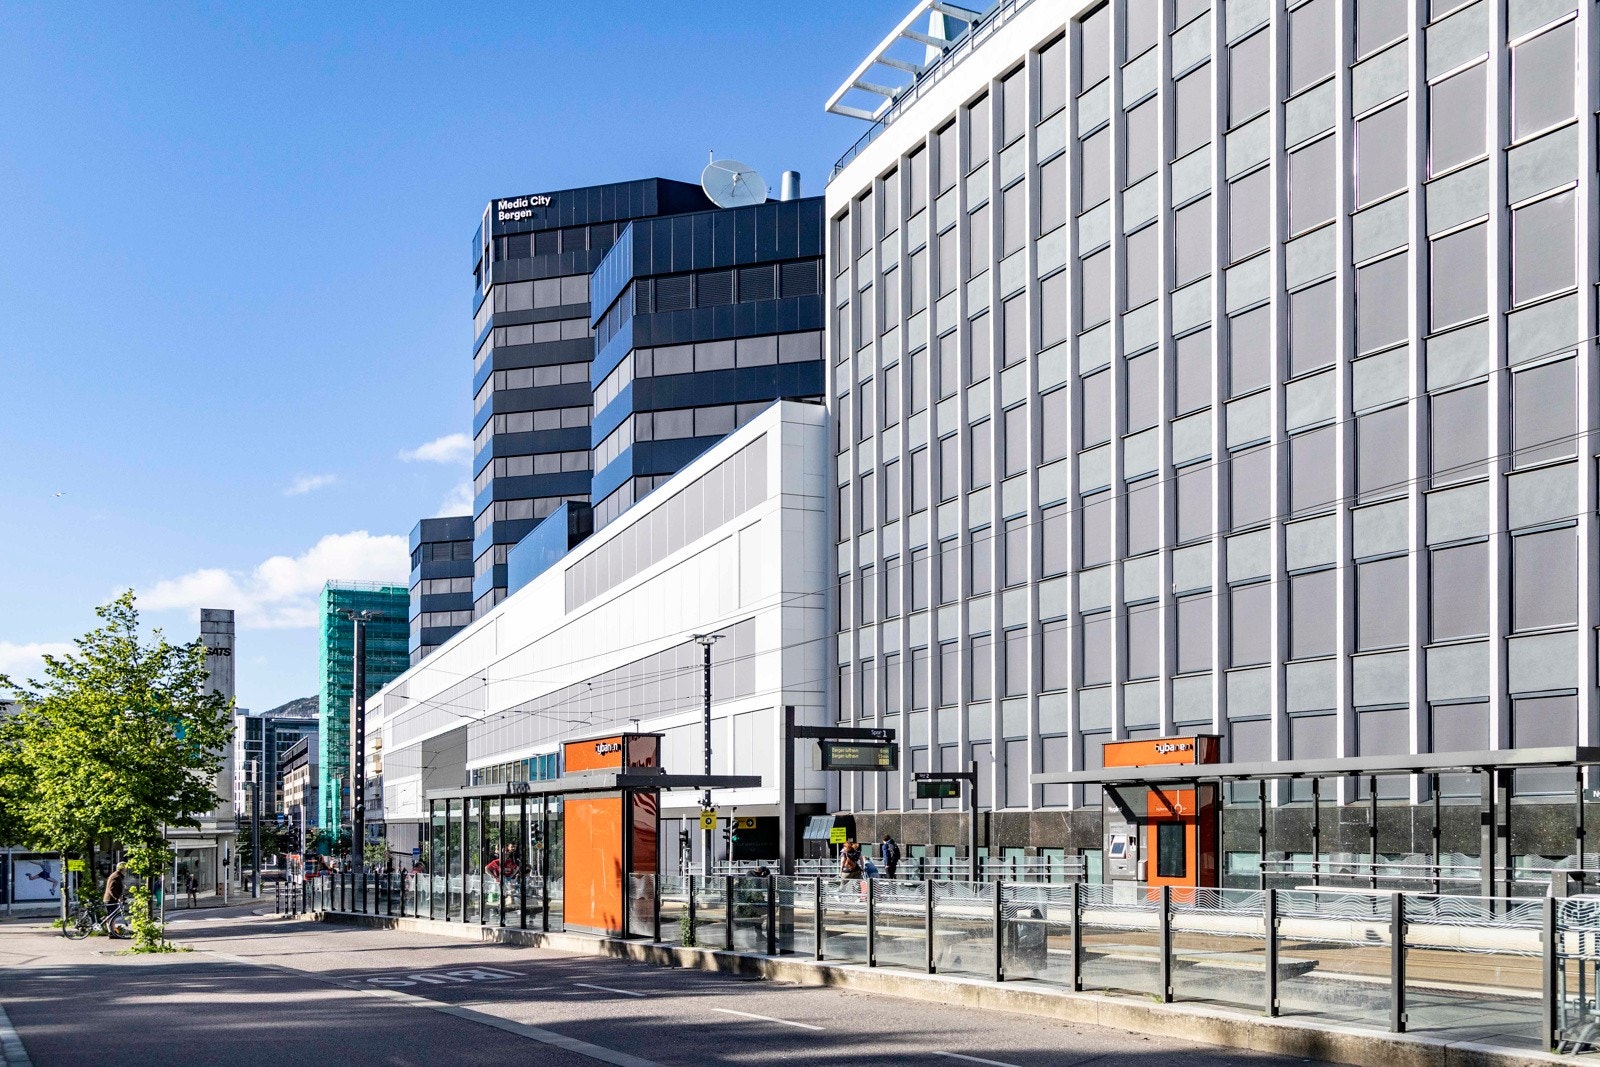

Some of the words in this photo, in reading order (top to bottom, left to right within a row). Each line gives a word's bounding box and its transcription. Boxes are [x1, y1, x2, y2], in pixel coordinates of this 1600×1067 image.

[498, 198, 528, 210] Media
[530, 195, 551, 206] City
[498, 209, 532, 221] Bergen
[205, 646, 232, 657] SATS
[883, 730, 887, 738] 1
